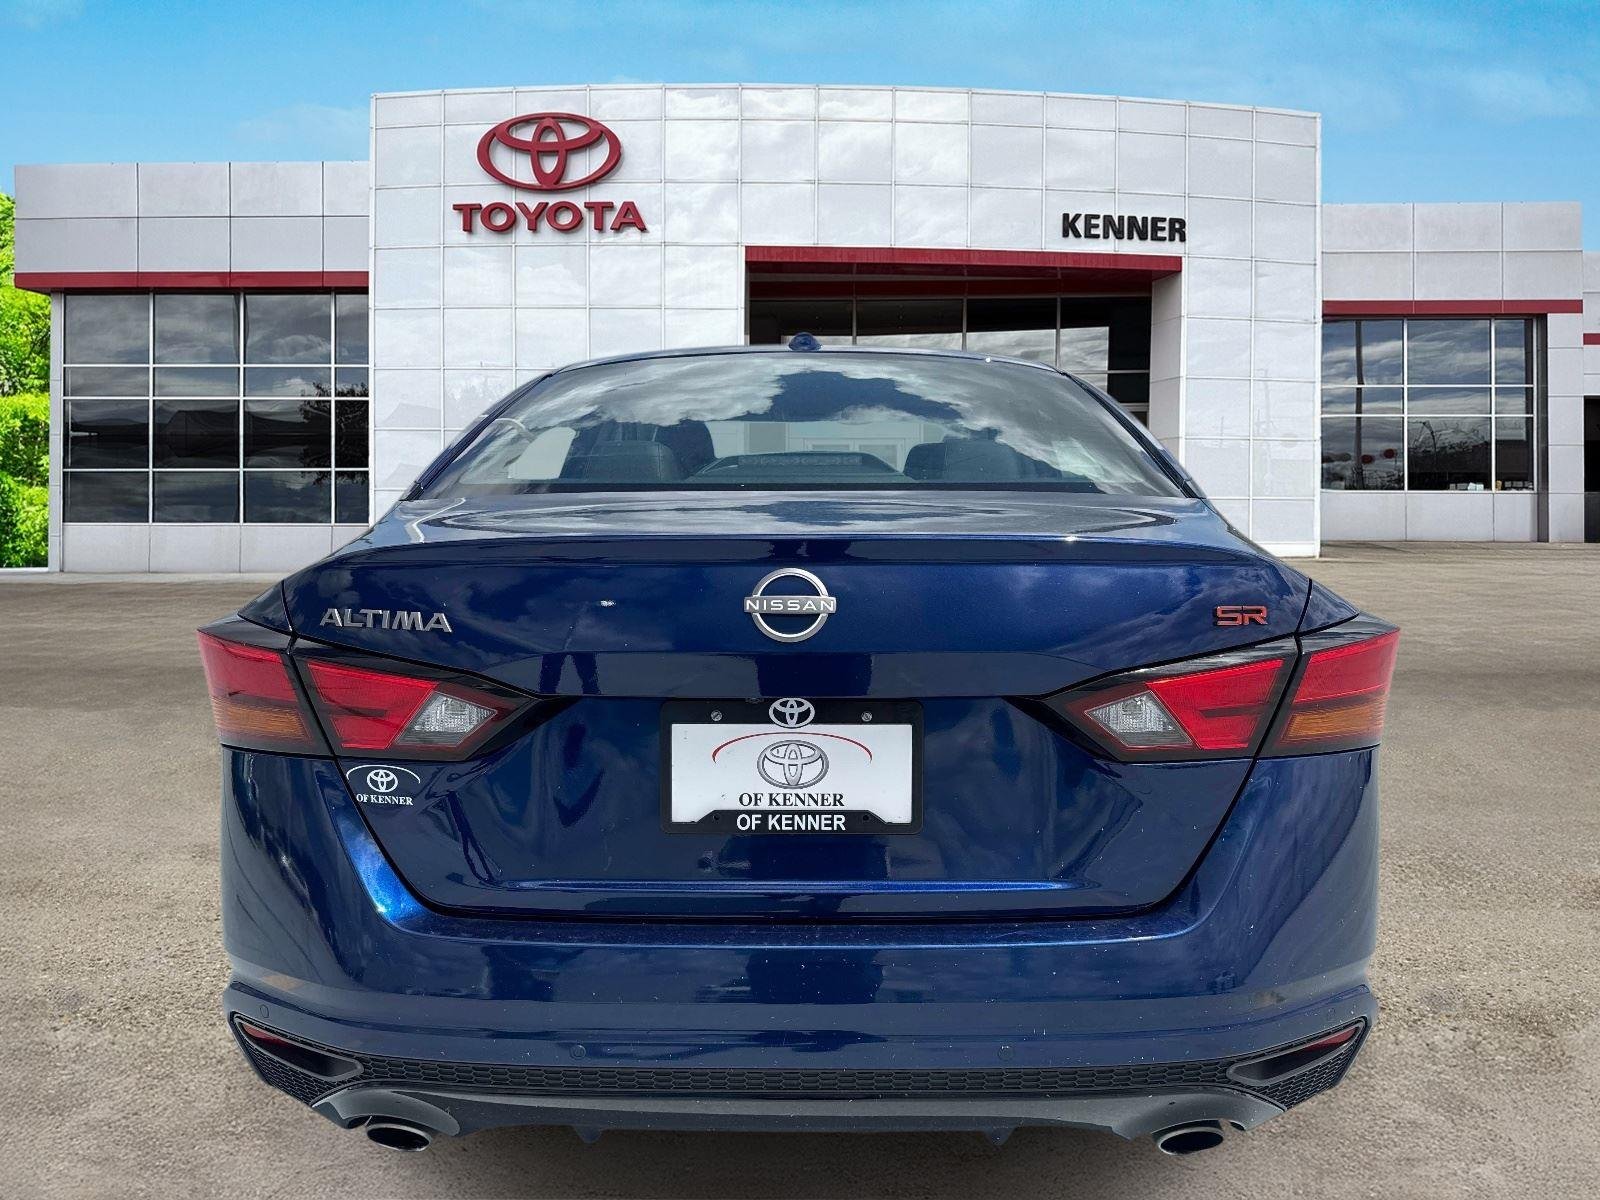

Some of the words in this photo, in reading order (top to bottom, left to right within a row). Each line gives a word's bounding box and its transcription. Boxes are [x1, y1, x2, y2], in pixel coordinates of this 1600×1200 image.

[452, 201, 647, 232] TOYOTA
[1062, 212, 1187, 242] KENNER
[746, 599, 834, 611] NISSAN
[319, 607, 453, 633] ALTIMA
[1216, 605, 1268, 626] SR
[356, 793, 369, 803] OF
[370, 794, 414, 806] KENNER
[738, 792, 764, 807] OF
[768, 792, 845, 807] KENNER
[736, 813, 762, 831] OF
[767, 813, 846, 831] KENNER
